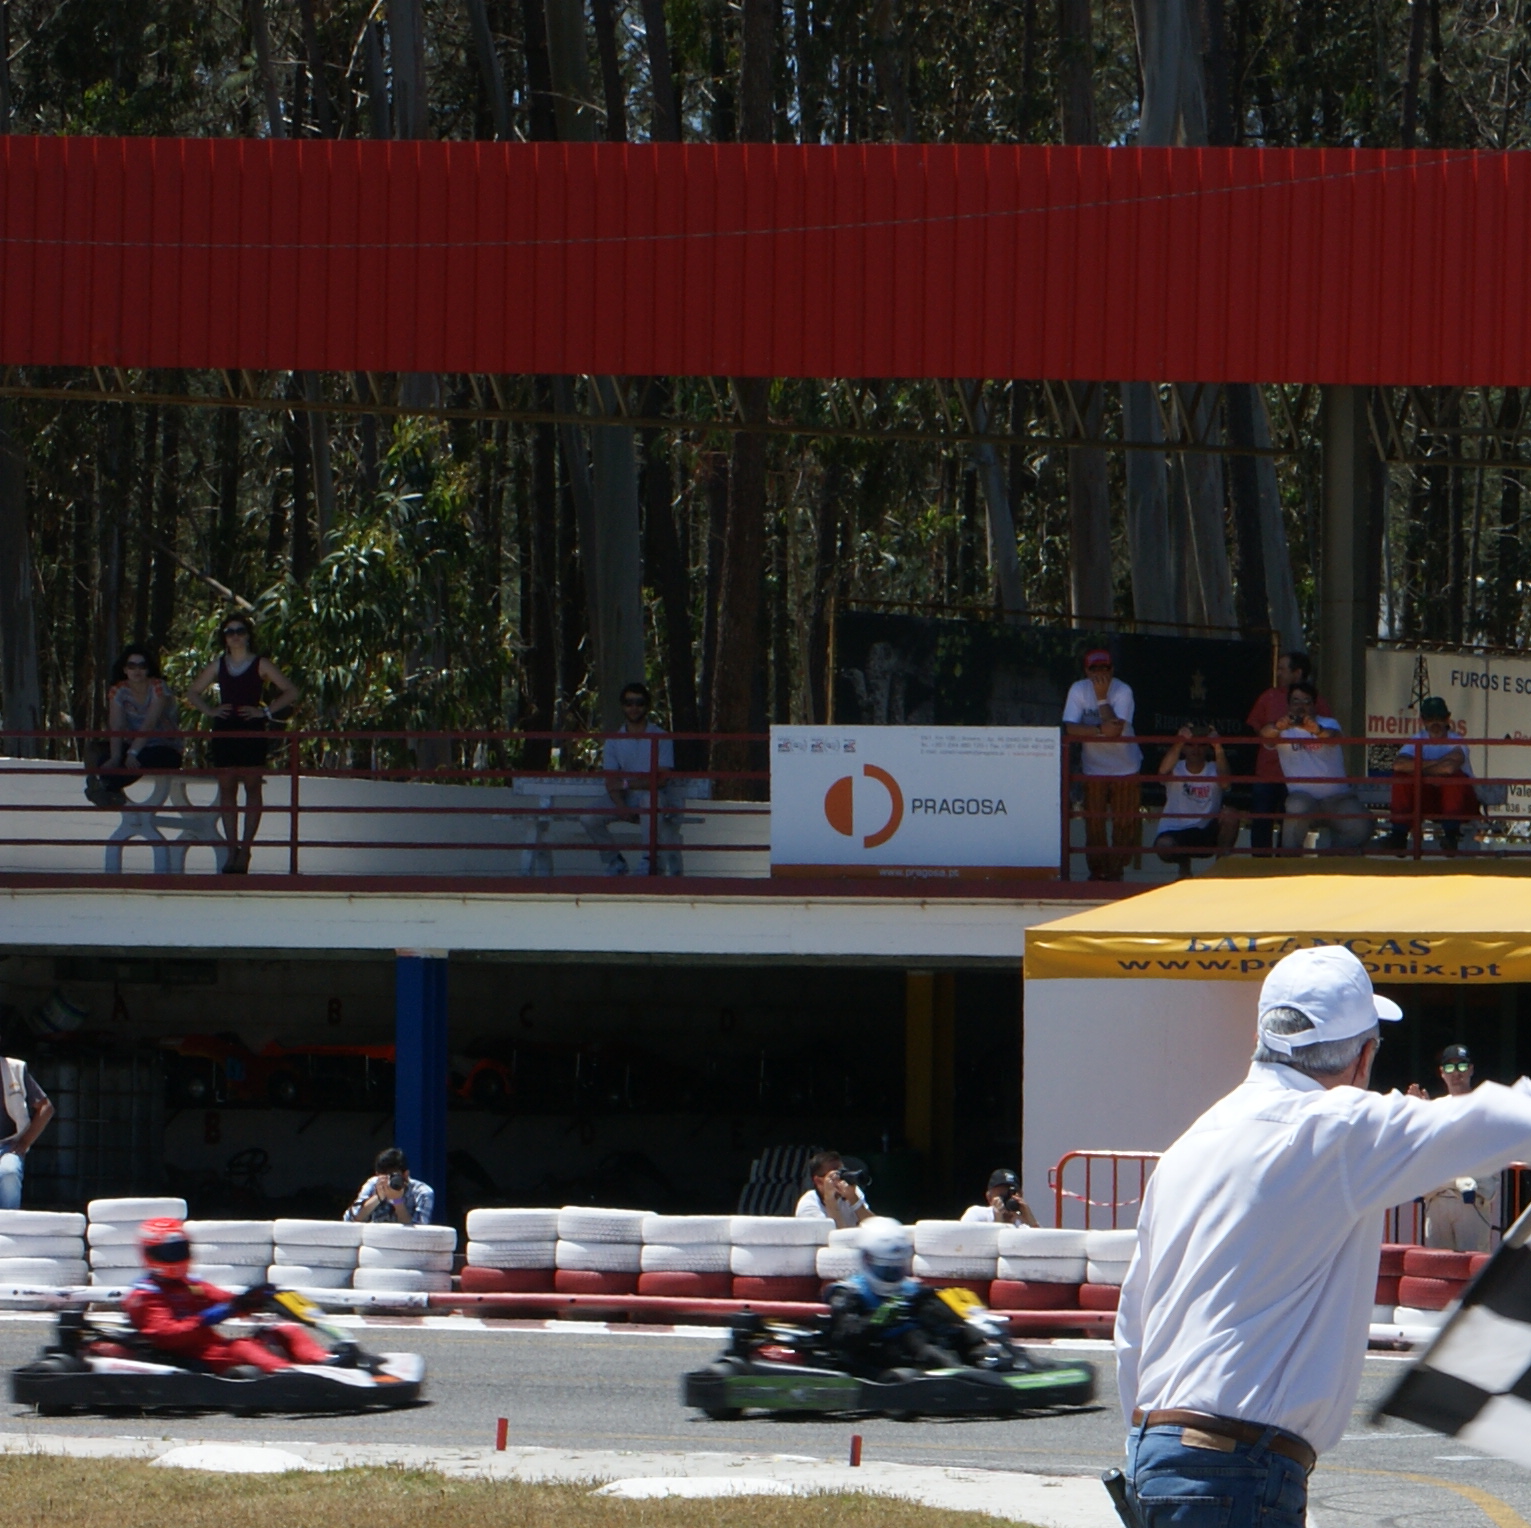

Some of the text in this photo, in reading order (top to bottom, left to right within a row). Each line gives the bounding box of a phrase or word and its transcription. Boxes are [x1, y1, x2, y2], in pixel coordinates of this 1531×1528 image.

[1451, 670, 1498, 691] FUROS
[1503, 676, 1511, 691] E
[912, 798, 1008, 815] PRAGOSA
[879, 868, 960, 878] www.pragosa.pt
